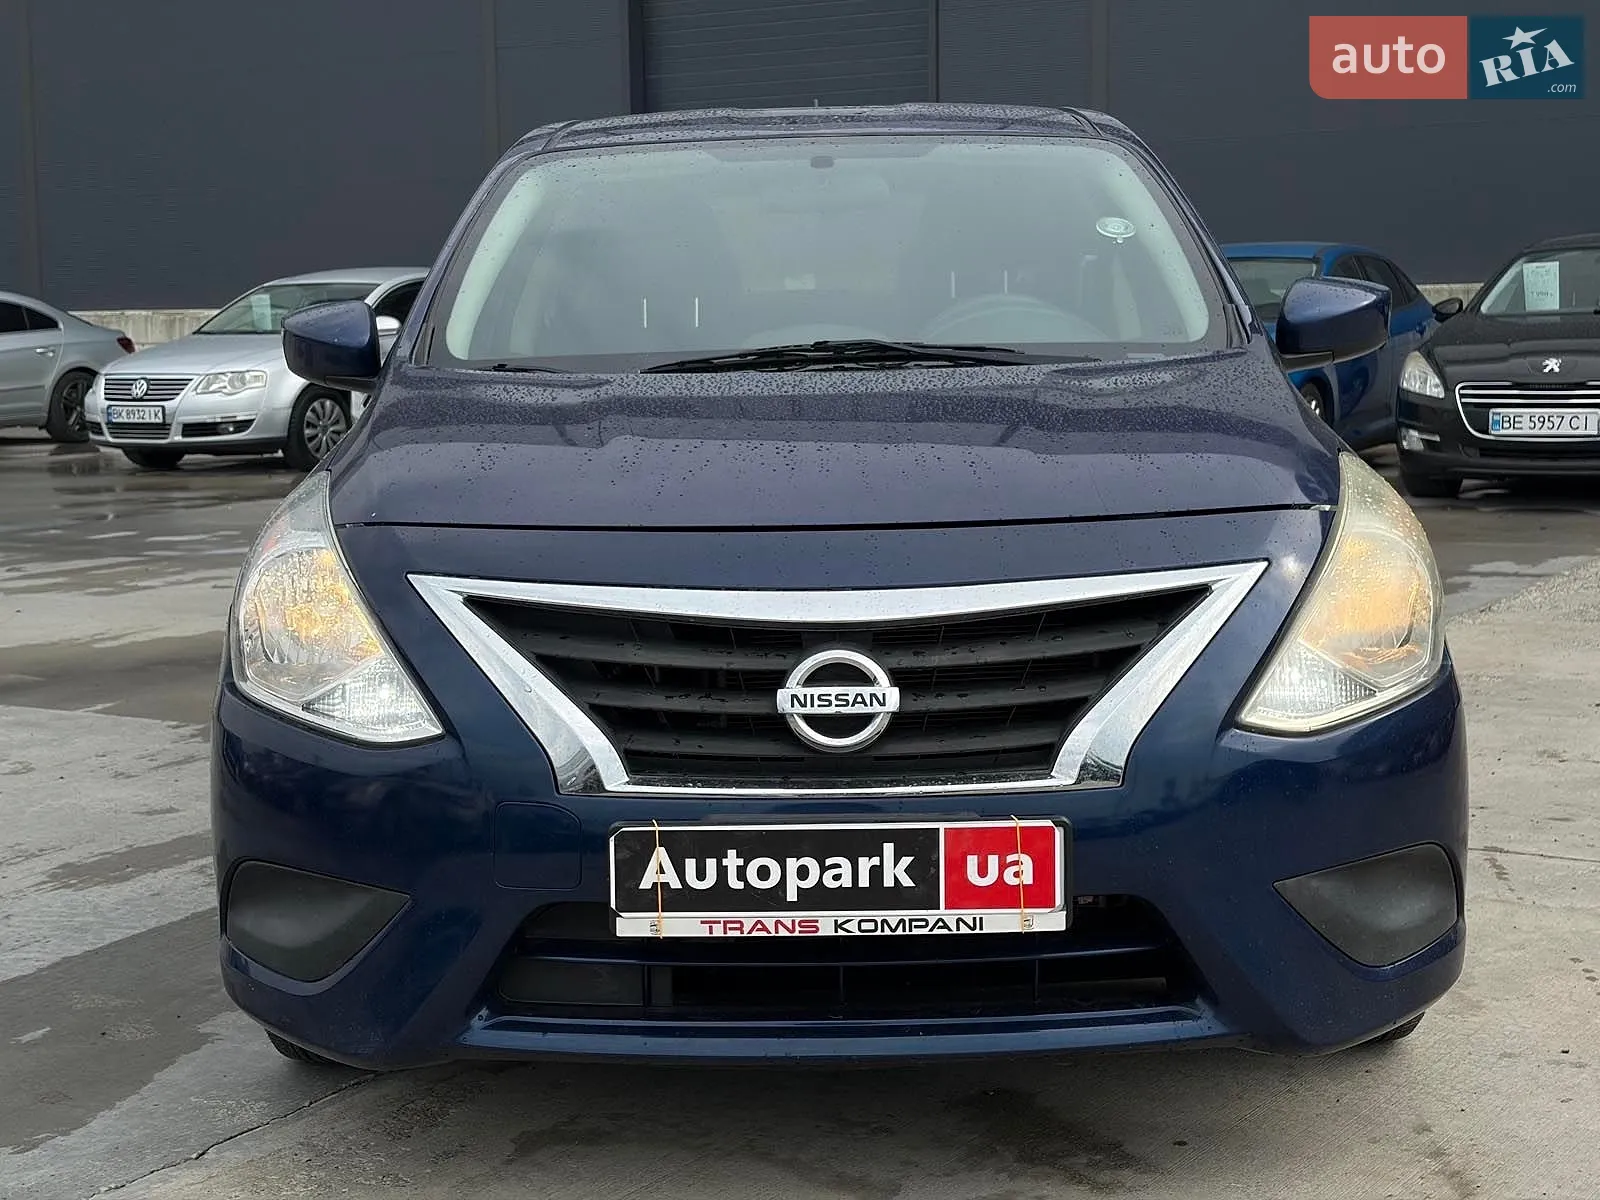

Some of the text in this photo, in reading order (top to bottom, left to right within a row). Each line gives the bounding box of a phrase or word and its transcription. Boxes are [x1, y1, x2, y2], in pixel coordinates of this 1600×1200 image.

[126, 408, 146, 420] 8932
[1501, 415, 1588, 431] BE 5957 CI
[790, 692, 887, 708] NISSAN
[638, 842, 1034, 902] Autopark ua
[700, 917, 984, 935] TRANS KOMPANI
